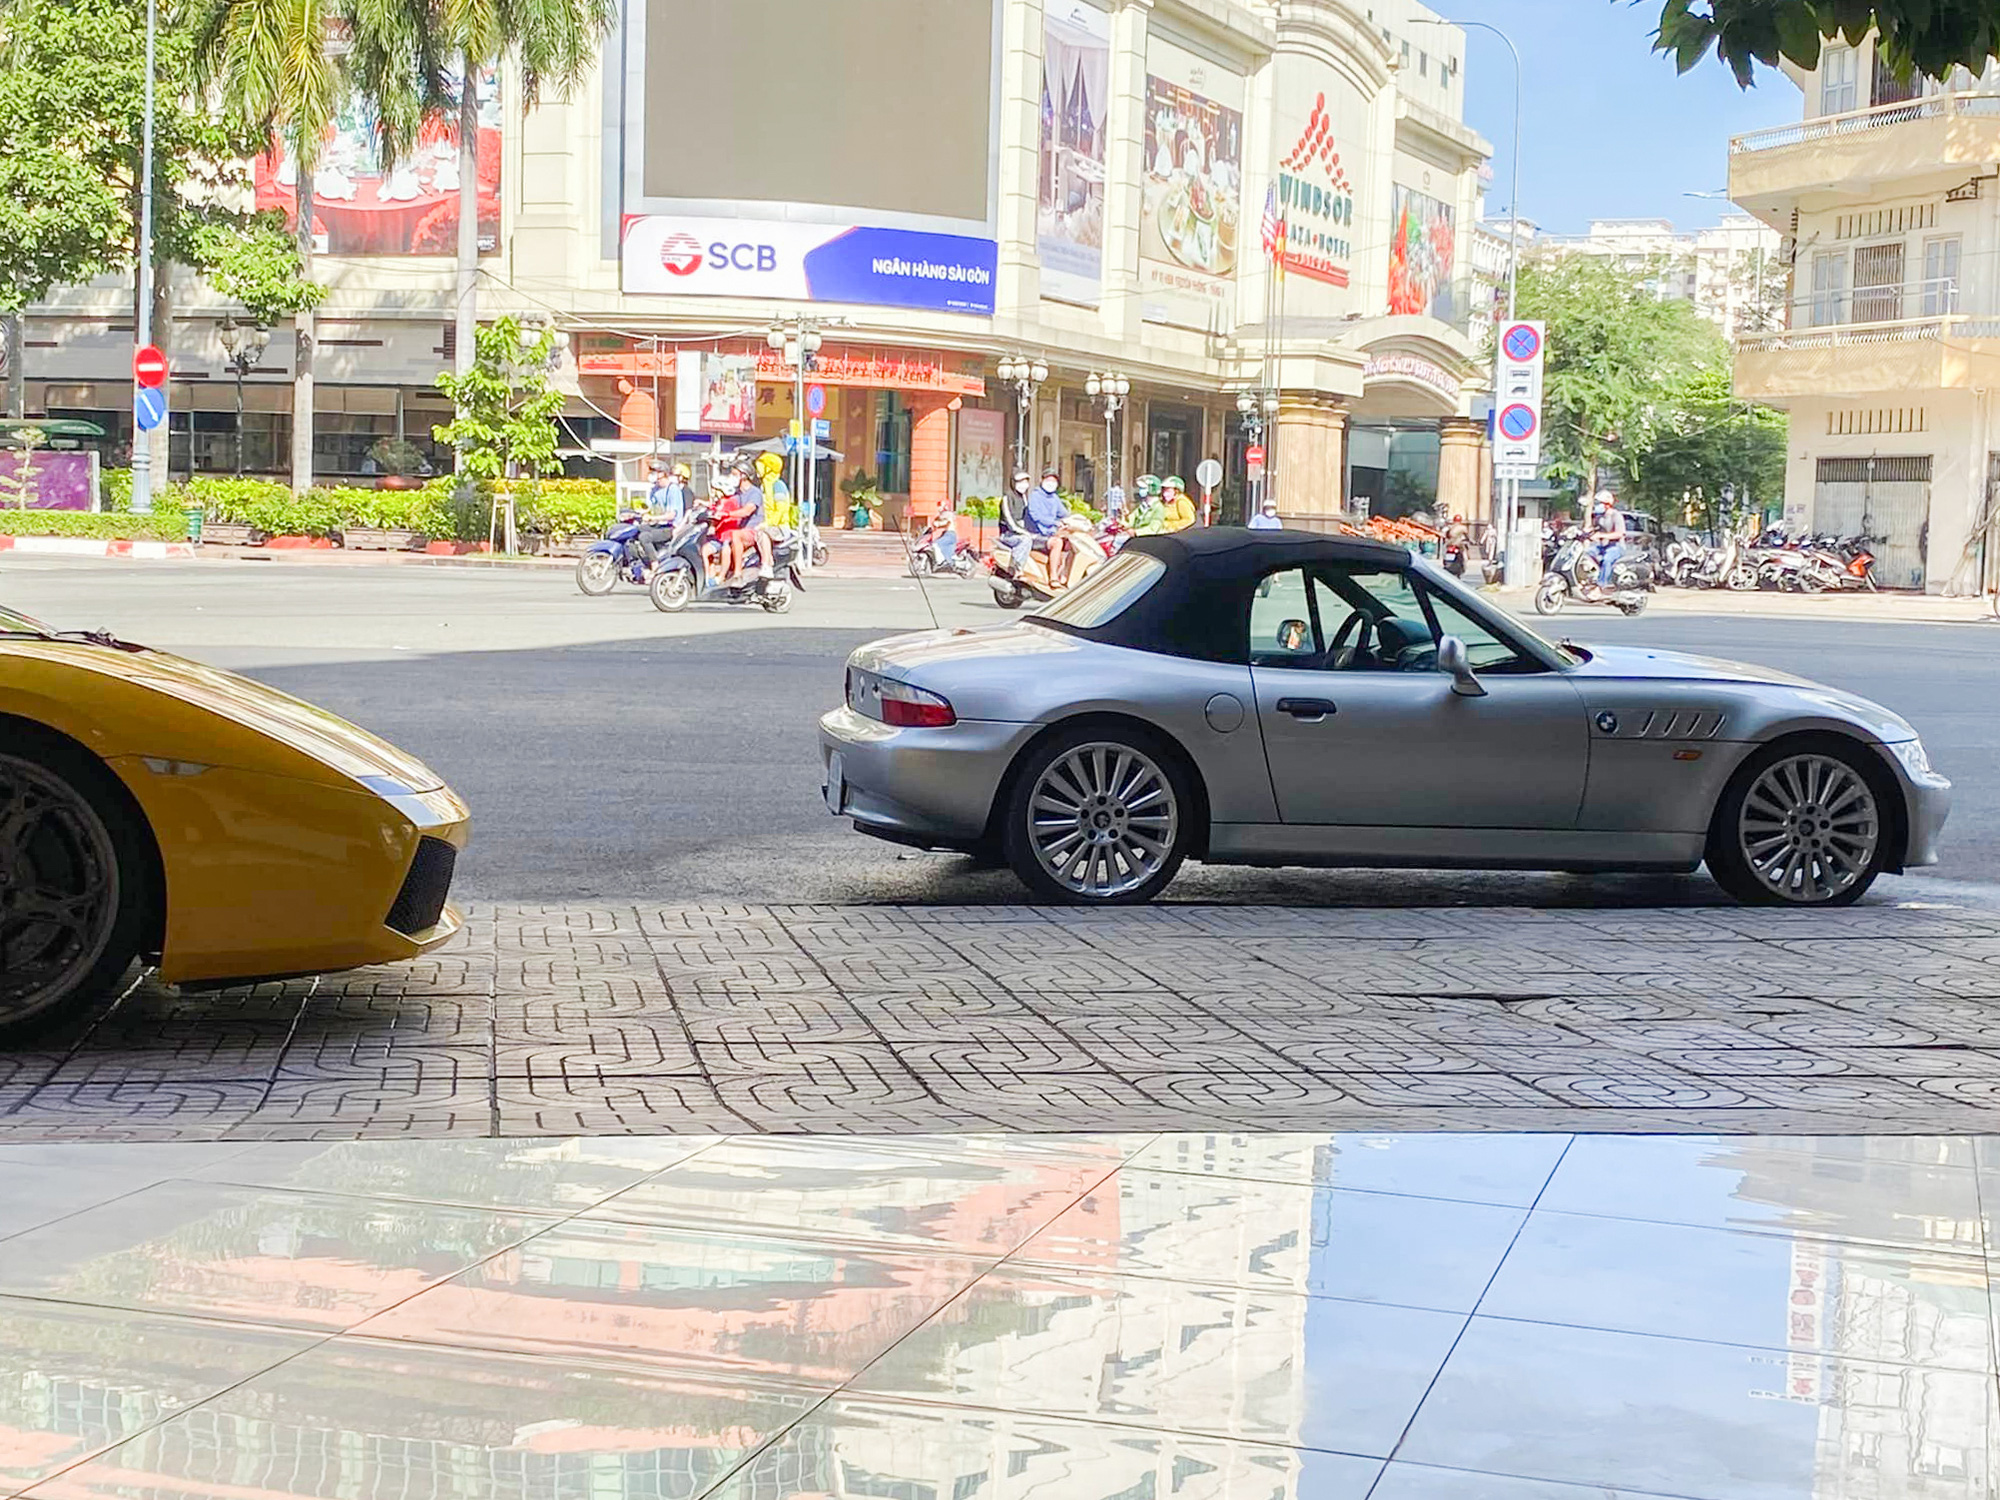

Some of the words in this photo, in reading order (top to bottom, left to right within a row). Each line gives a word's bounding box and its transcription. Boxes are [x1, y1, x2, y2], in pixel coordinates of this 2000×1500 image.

[1279, 173, 1352, 229] WINDSOR
[708, 241, 777, 272] SCB
[872, 257, 911, 276] NGÂN
[912, 260, 947, 280] HÀNG
[948, 264, 966, 282] SÀI
[967, 266, 990, 285] GÒN
